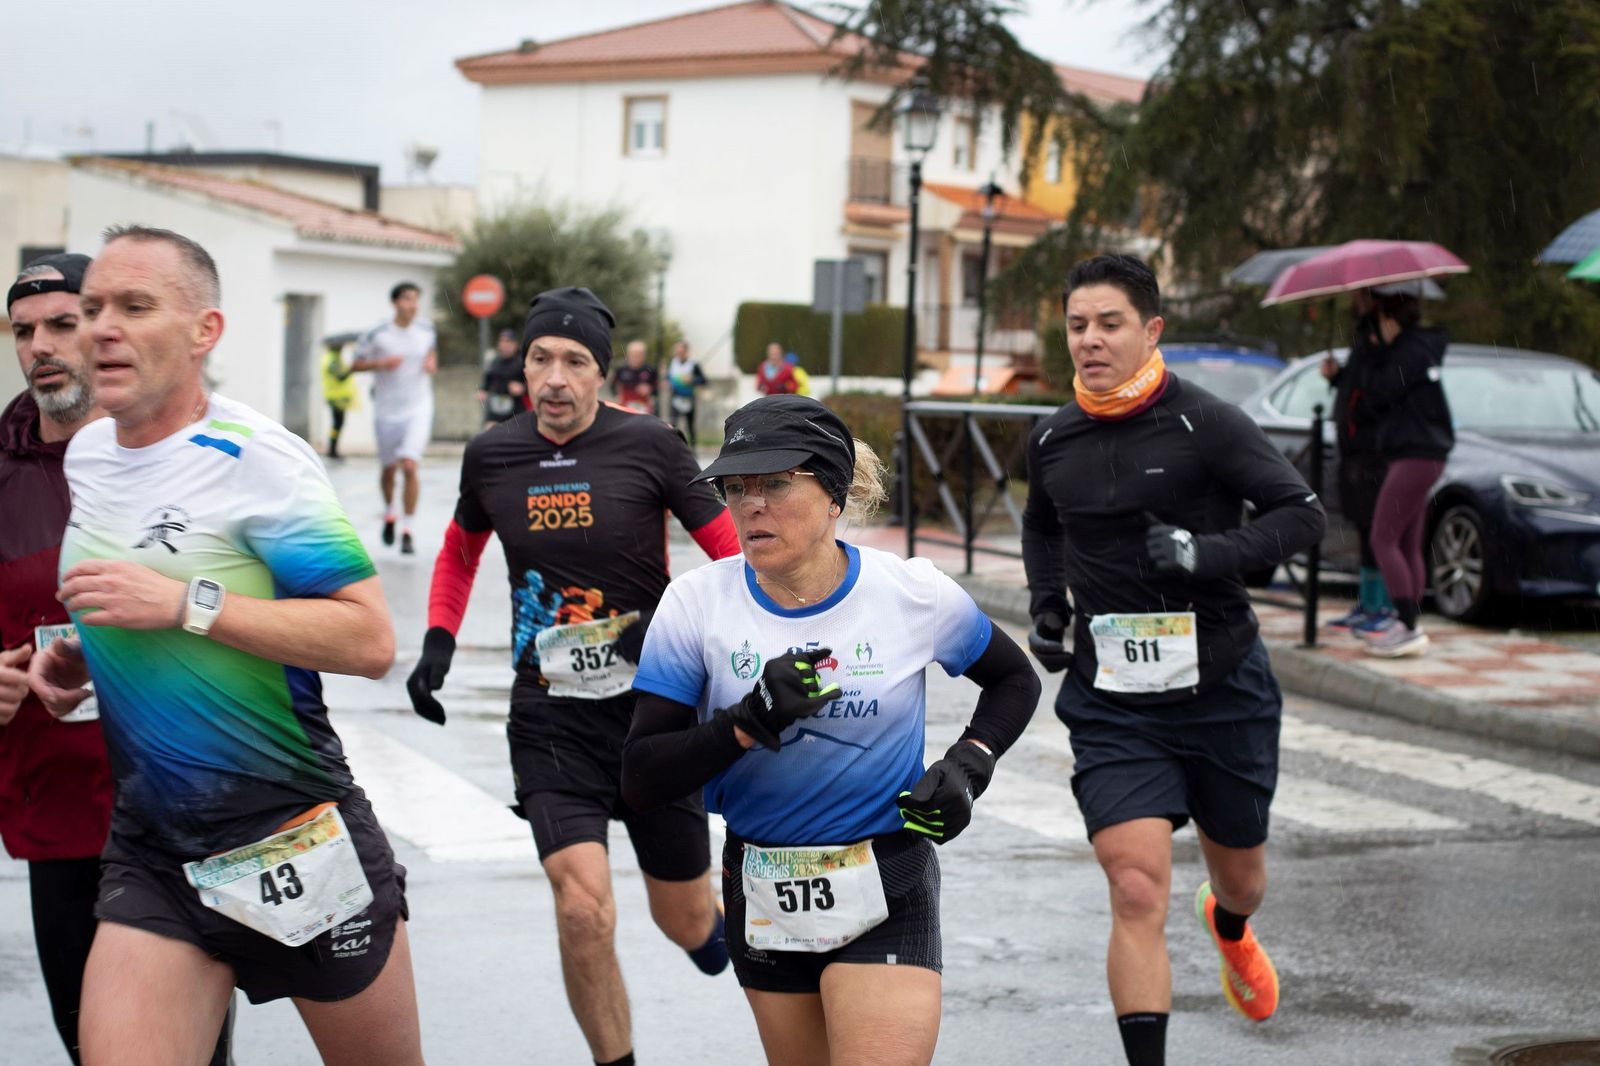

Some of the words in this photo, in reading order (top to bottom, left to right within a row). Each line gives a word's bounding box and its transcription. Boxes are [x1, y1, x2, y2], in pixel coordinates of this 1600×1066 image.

[527, 486, 552, 496] GRAN
[553, 482, 591, 493] PREMIO
[527, 491, 592, 509] FONDO
[528, 506, 594, 530] 2025
[570, 643, 617, 672] 352
[1124, 639, 1160, 662] 611
[259, 862, 304, 907] 43
[774, 877, 835, 913] 573
